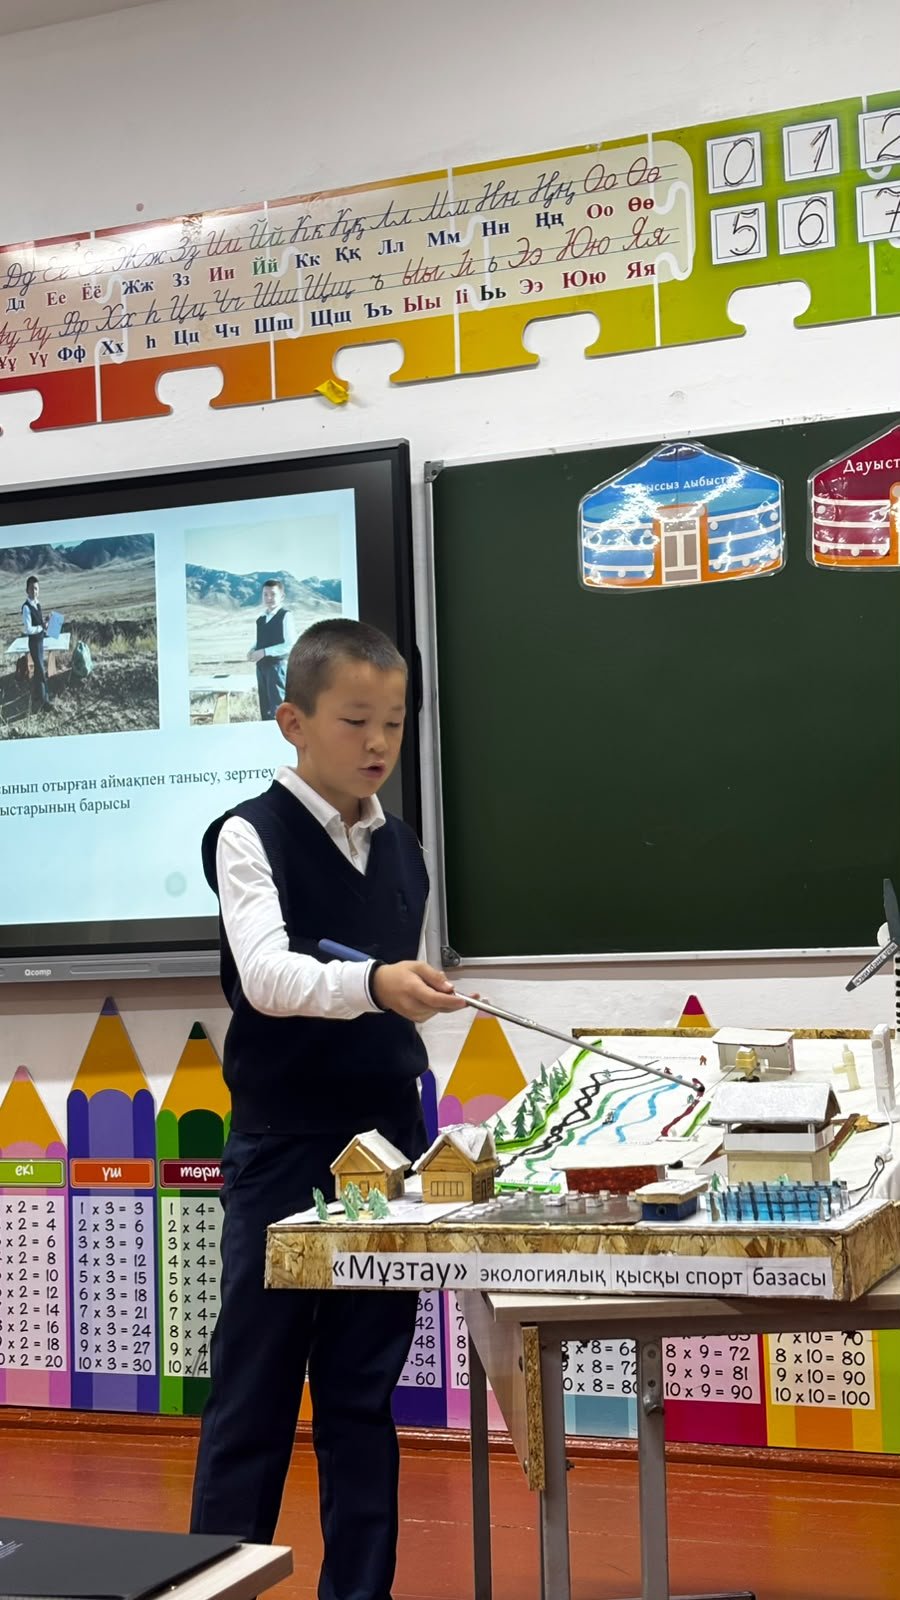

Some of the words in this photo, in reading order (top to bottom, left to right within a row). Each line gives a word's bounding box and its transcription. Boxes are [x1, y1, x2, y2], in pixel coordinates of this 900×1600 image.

[724, 137, 754, 187] 0
[810, 125, 831, 172] 1
[730, 208, 759, 256] 5
[798, 196, 827, 247] 6
[47, 292, 66, 306] Ее
[82, 283, 101, 300] Ёё
[122, 279, 154, 295] Жж
[172, 272, 190, 287] Зз
[209, 266, 235, 282] Ии
[252, 257, 278, 275] Йй
[295, 253, 320, 269] Кк
[335, 246, 361, 263] Ққ
[378, 239, 405, 256] Лл
[427, 230, 461, 248] Мм
[482, 221, 510, 237] Нн
[536, 212, 564, 229] Ңң
[587, 203, 614, 219] Оо
[628, 197, 655, 212] Өө
[57, 345, 86, 363] Фф
[102, 340, 124, 355] Хх
[174, 330, 199, 346] Цц
[215, 323, 240, 339] Чч
[254, 317, 293, 334] Шш
[310, 309, 352, 327] Щщ
[364, 303, 393, 318] Ъъ
[403, 295, 441, 313] Ыы
[480, 285, 506, 301] Ьь
[519, 279, 543, 294] Ээ
[563, 270, 606, 289] Юю
[626, 262, 656, 280] Яя
[0, 782, 39, 795] ынып
[42, 780, 97, 795] отырған
[100, 774, 165, 790] аймақпен
[169, 770, 221, 784] танысу,
[224, 767, 275, 784] зерттеу
[80, 798, 130, 813] барысы
[81, 1202, 83, 1214] 1
[105, 1202, 114, 1214] 3
[135, 1202, 143, 1215] 3
[170, 1203, 173, 1215] 1
[196, 1203, 205, 1215] 4
[79, 1219, 87, 1231] 2
[106, 1219, 114, 1231] 3
[135, 1220, 143, 1232] 6
[168, 1220, 176, 1232] 2
[196, 1220, 206, 1232] 4
[79, 1236, 87, 1248] 3
[106, 1236, 114, 1248] 3
[136, 1237, 143, 1249] 9
[79, 1254, 88, 1266] 4
[106, 1253, 115, 1266] 3
[134, 1254, 146, 1267] 12
[19, 1269, 27, 1280] 2
[46, 1269, 58, 1281] 10
[80, 1271, 87, 1283] 5
[106, 1270, 115, 1283] 3
[135, 1272, 146, 1284] 15
[333, 1255, 467, 1287] «Мұзтау»
[480, 1267, 606, 1287] экологиялық
[615, 1269, 679, 1288] қысқы
[686, 1270, 743, 1289] спорт
[753, 1267, 826, 1286] базасы
[414, 1335, 435, 1349] 48
[666, 1344, 676, 1358] 8
[700, 1345, 709, 1358] 9
[730, 1346, 750, 1361] 72
[776, 1348, 786, 1362] 8
[807, 1349, 822, 1363] 10
[842, 1351, 865, 1366] 80
[416, 1372, 435, 1385] 60
[457, 1371, 470, 1387] 10
[667, 1363, 676, 1377] 9
[701, 1364, 710, 1378] 9
[733, 1366, 747, 1380] 81
[777, 1368, 786, 1381] 9
[808, 1369, 823, 1383] 10
[843, 1371, 865, 1385] 90
[776, 1387, 791, 1401] 10
[809, 1389, 824, 1403] 10
[842, 1391, 870, 1406] 100
